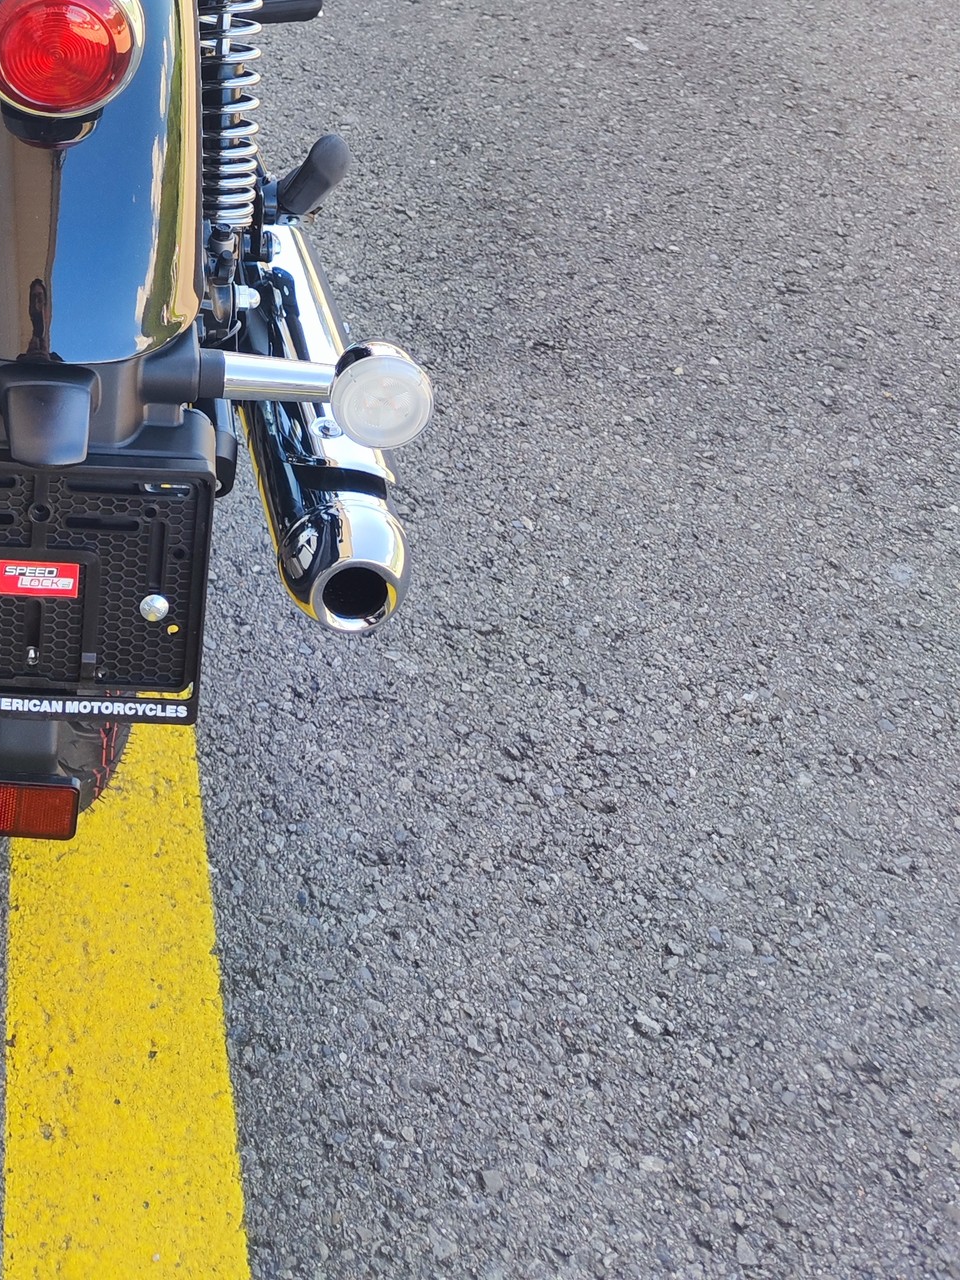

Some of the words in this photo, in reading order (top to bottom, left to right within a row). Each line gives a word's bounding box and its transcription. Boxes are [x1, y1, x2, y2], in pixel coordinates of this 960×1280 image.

[4, 566, 58, 577] SPEED
[19, 578, 60, 588] LOCK
[65, 701, 188, 718] MOTORCYCLES
